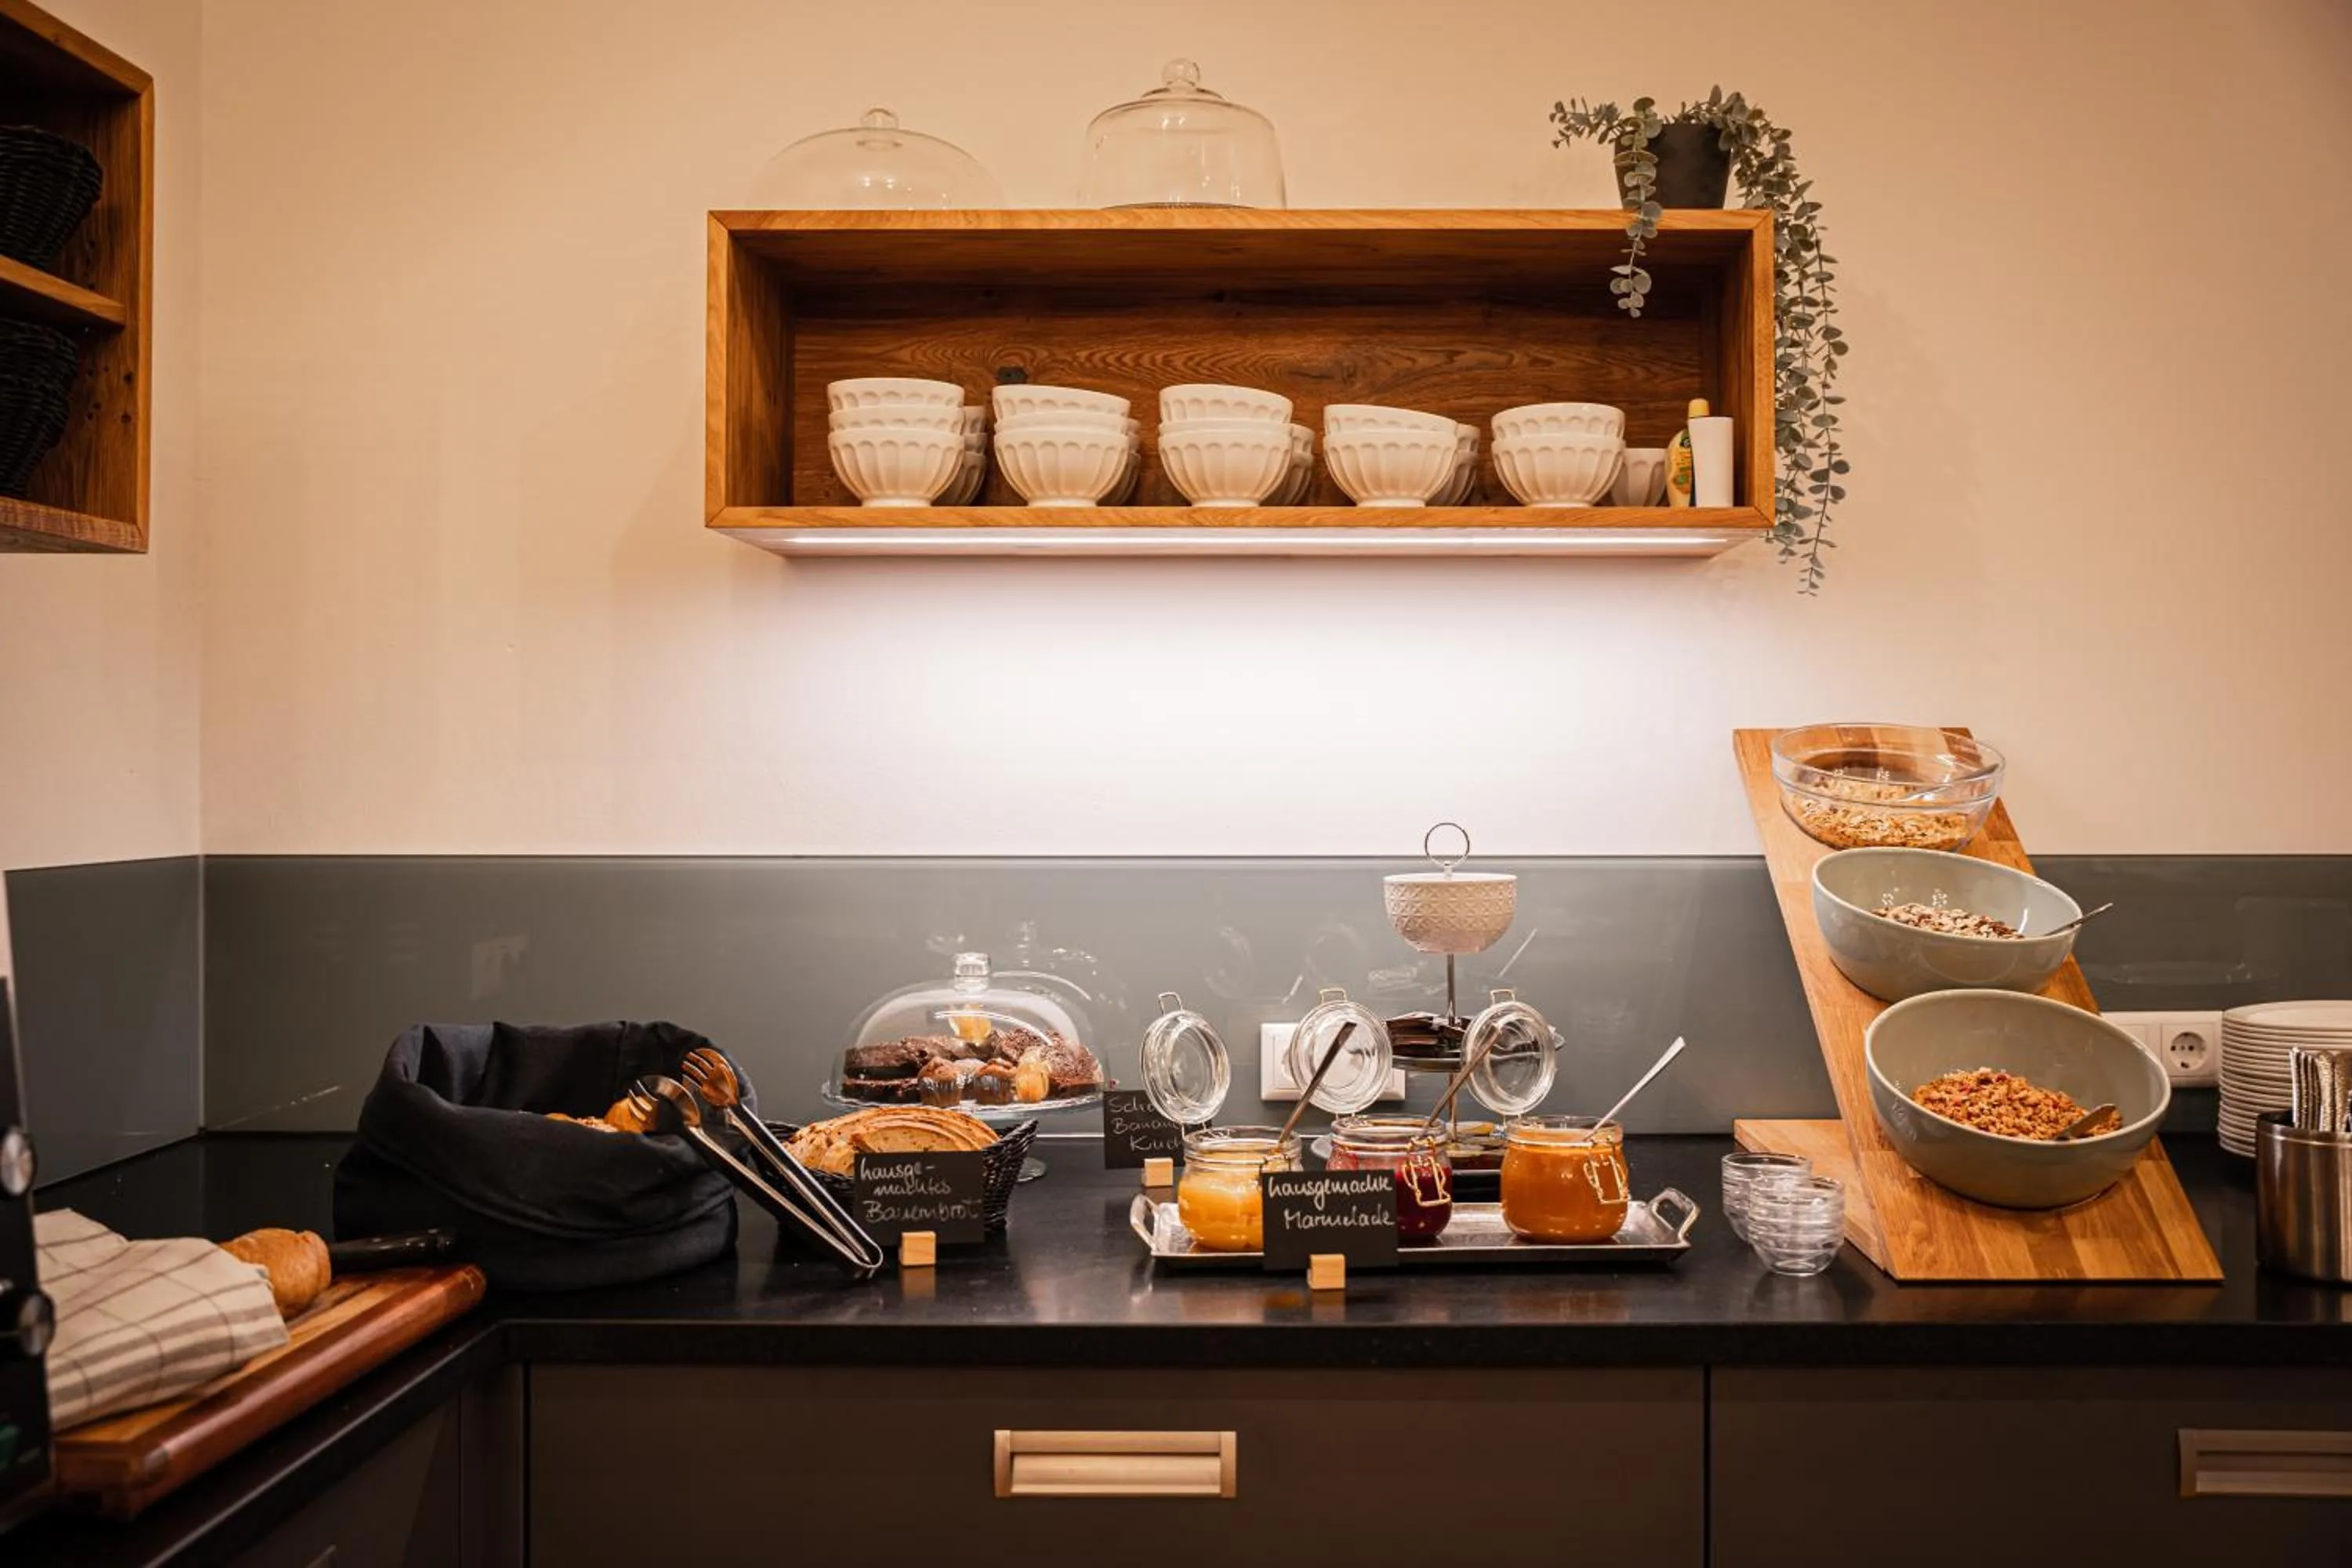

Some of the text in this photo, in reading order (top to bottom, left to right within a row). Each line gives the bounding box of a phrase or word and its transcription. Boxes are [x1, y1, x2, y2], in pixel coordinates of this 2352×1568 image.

[1108, 1095, 1156, 1112] Scho
[873, 1178, 952, 1197] machtes
[1267, 1174, 1393, 1210] hausgemachte
[862, 1199, 982, 1222] Bauernbrot
[1283, 1203, 1396, 1229] Marmelade
